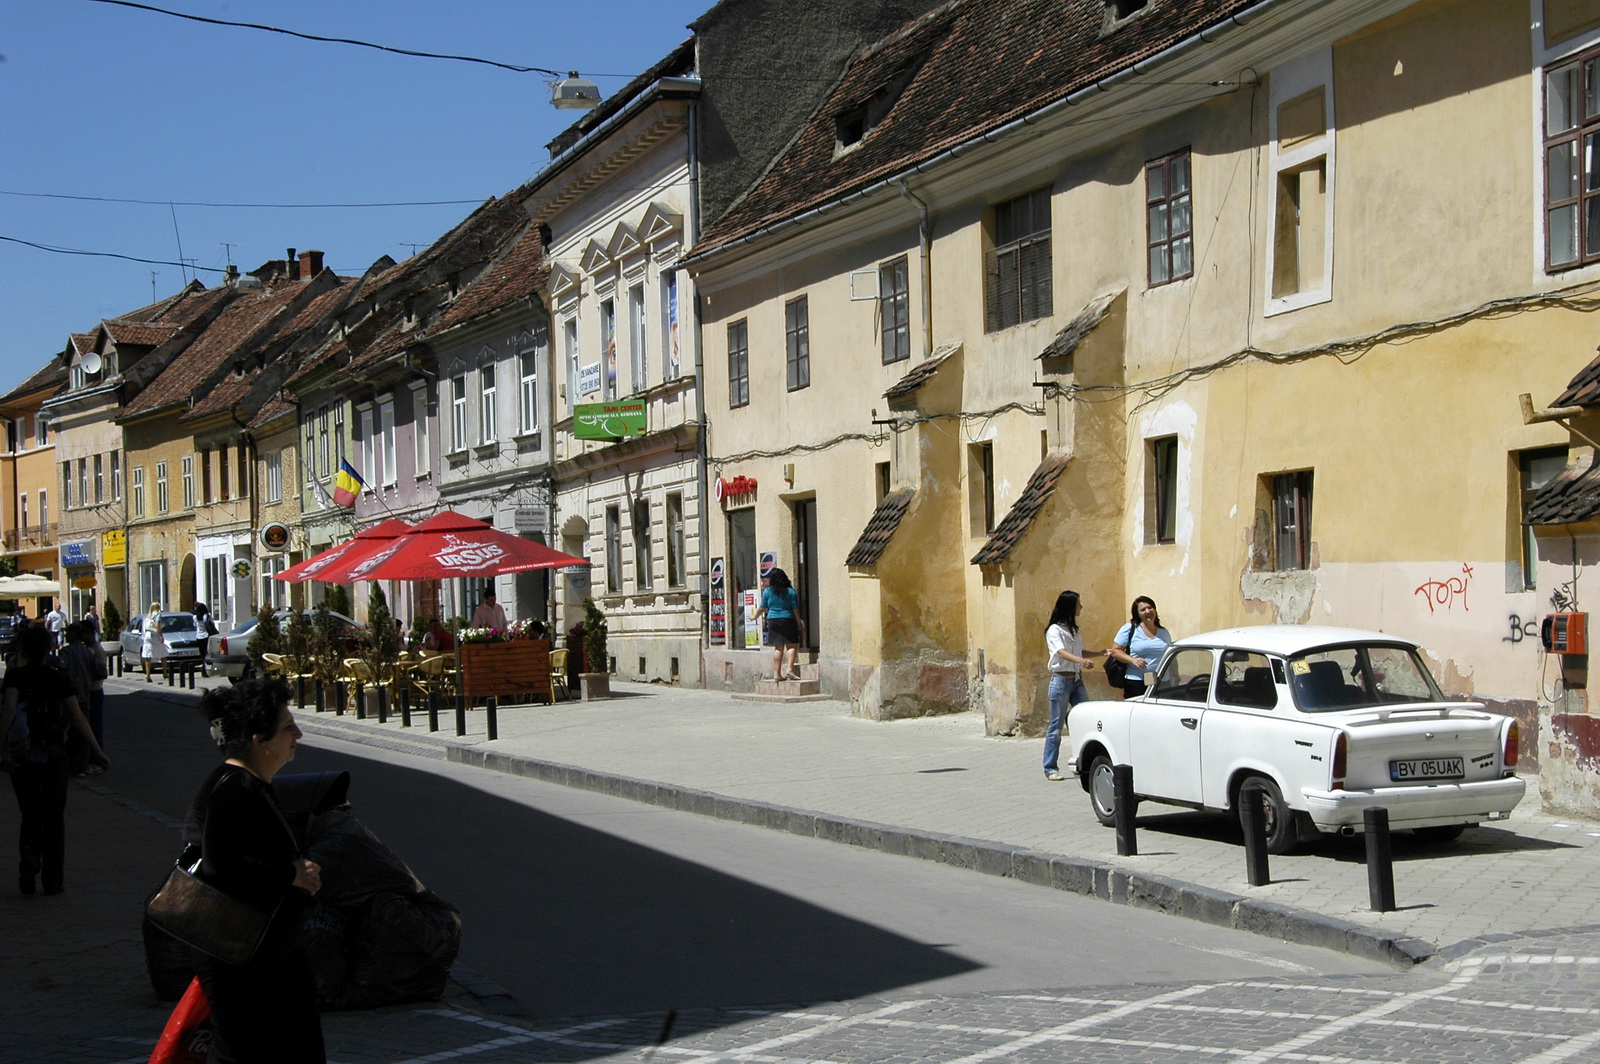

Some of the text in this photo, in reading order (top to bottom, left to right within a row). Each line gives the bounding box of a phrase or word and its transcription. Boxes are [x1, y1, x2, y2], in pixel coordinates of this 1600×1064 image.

[620, 404, 643, 412] CENTER
[435, 544, 504, 566] URSUS
[1398, 762, 1416, 777] BV
